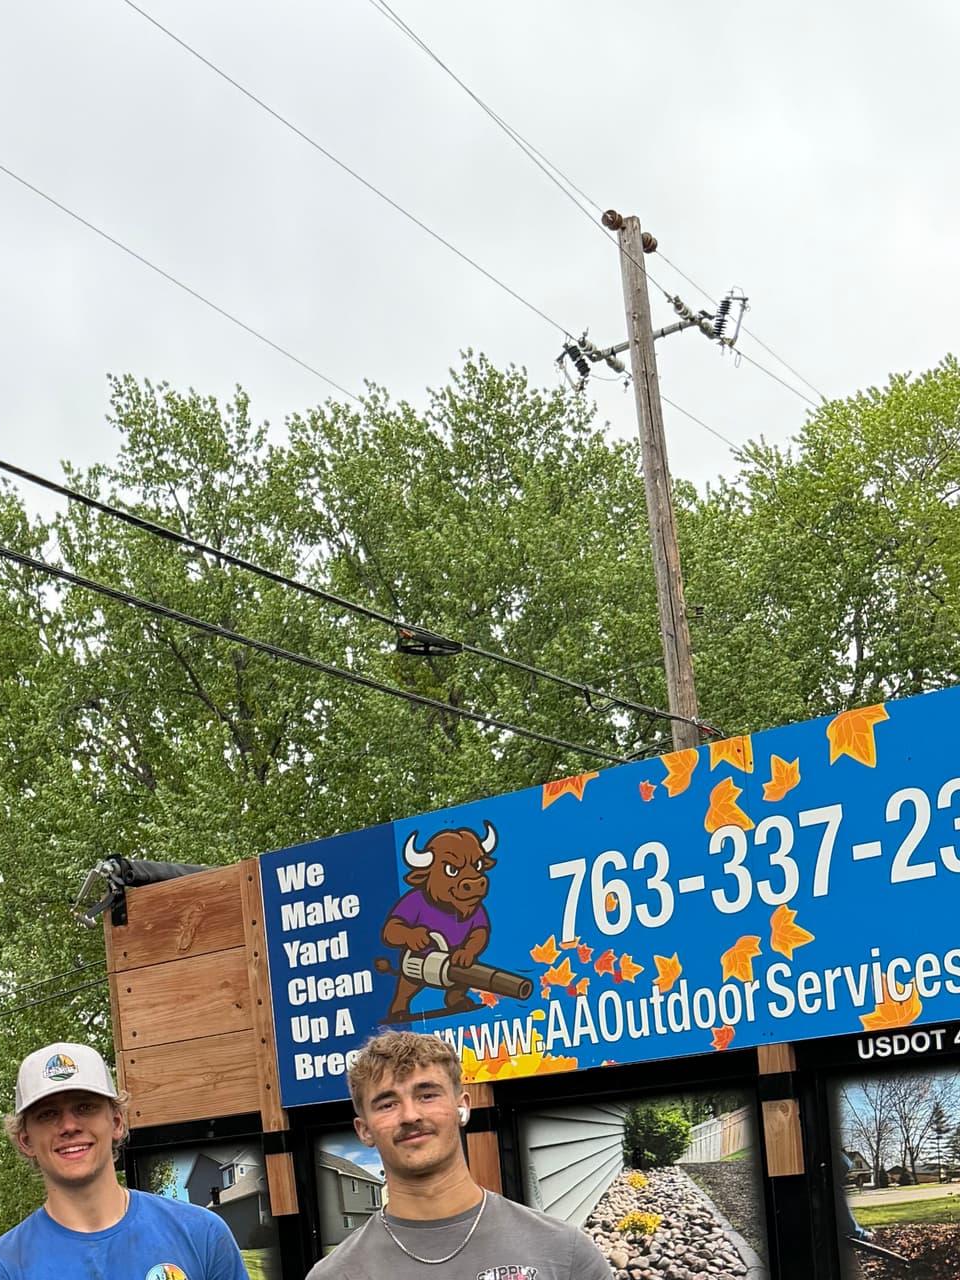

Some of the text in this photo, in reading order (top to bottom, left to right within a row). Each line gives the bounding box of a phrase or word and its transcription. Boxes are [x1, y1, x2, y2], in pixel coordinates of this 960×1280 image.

[276, 861, 325, 894] We
[280, 894, 361, 932] Make
[282, 931, 349, 968] Yard
[287, 969, 373, 1006] Clean
[290, 1008, 356, 1043] Up A
[857, 1029, 946, 1059] USDOT
